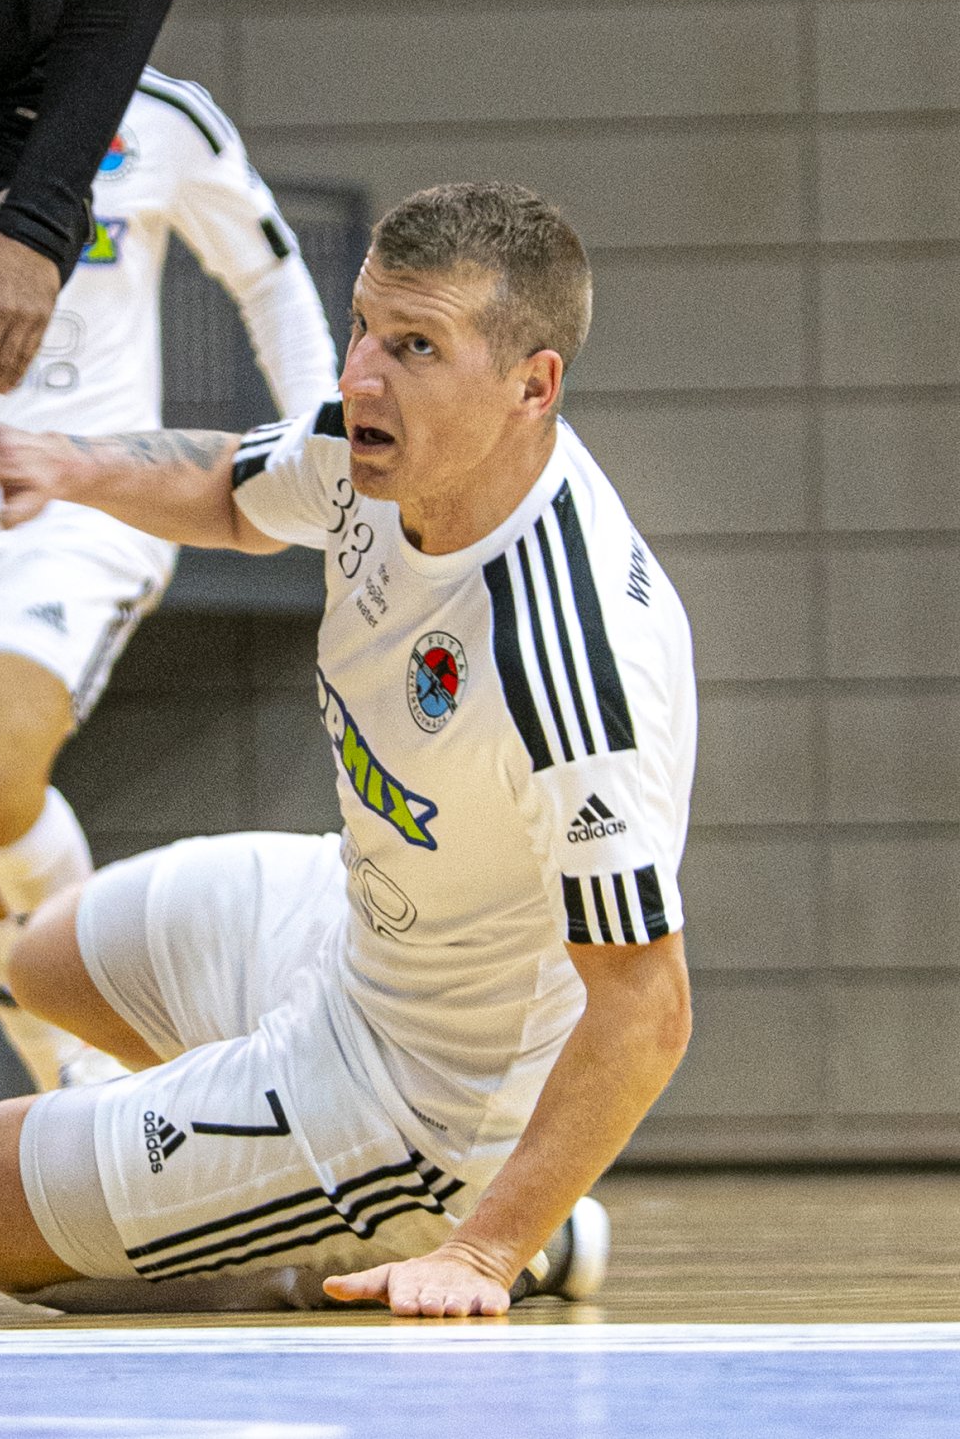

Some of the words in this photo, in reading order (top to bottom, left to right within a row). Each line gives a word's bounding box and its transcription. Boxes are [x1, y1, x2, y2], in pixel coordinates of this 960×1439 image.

[567, 819, 627, 843] adidas
[190, 1089, 291, 1137] 7
[143, 1111, 164, 1174] adidas
